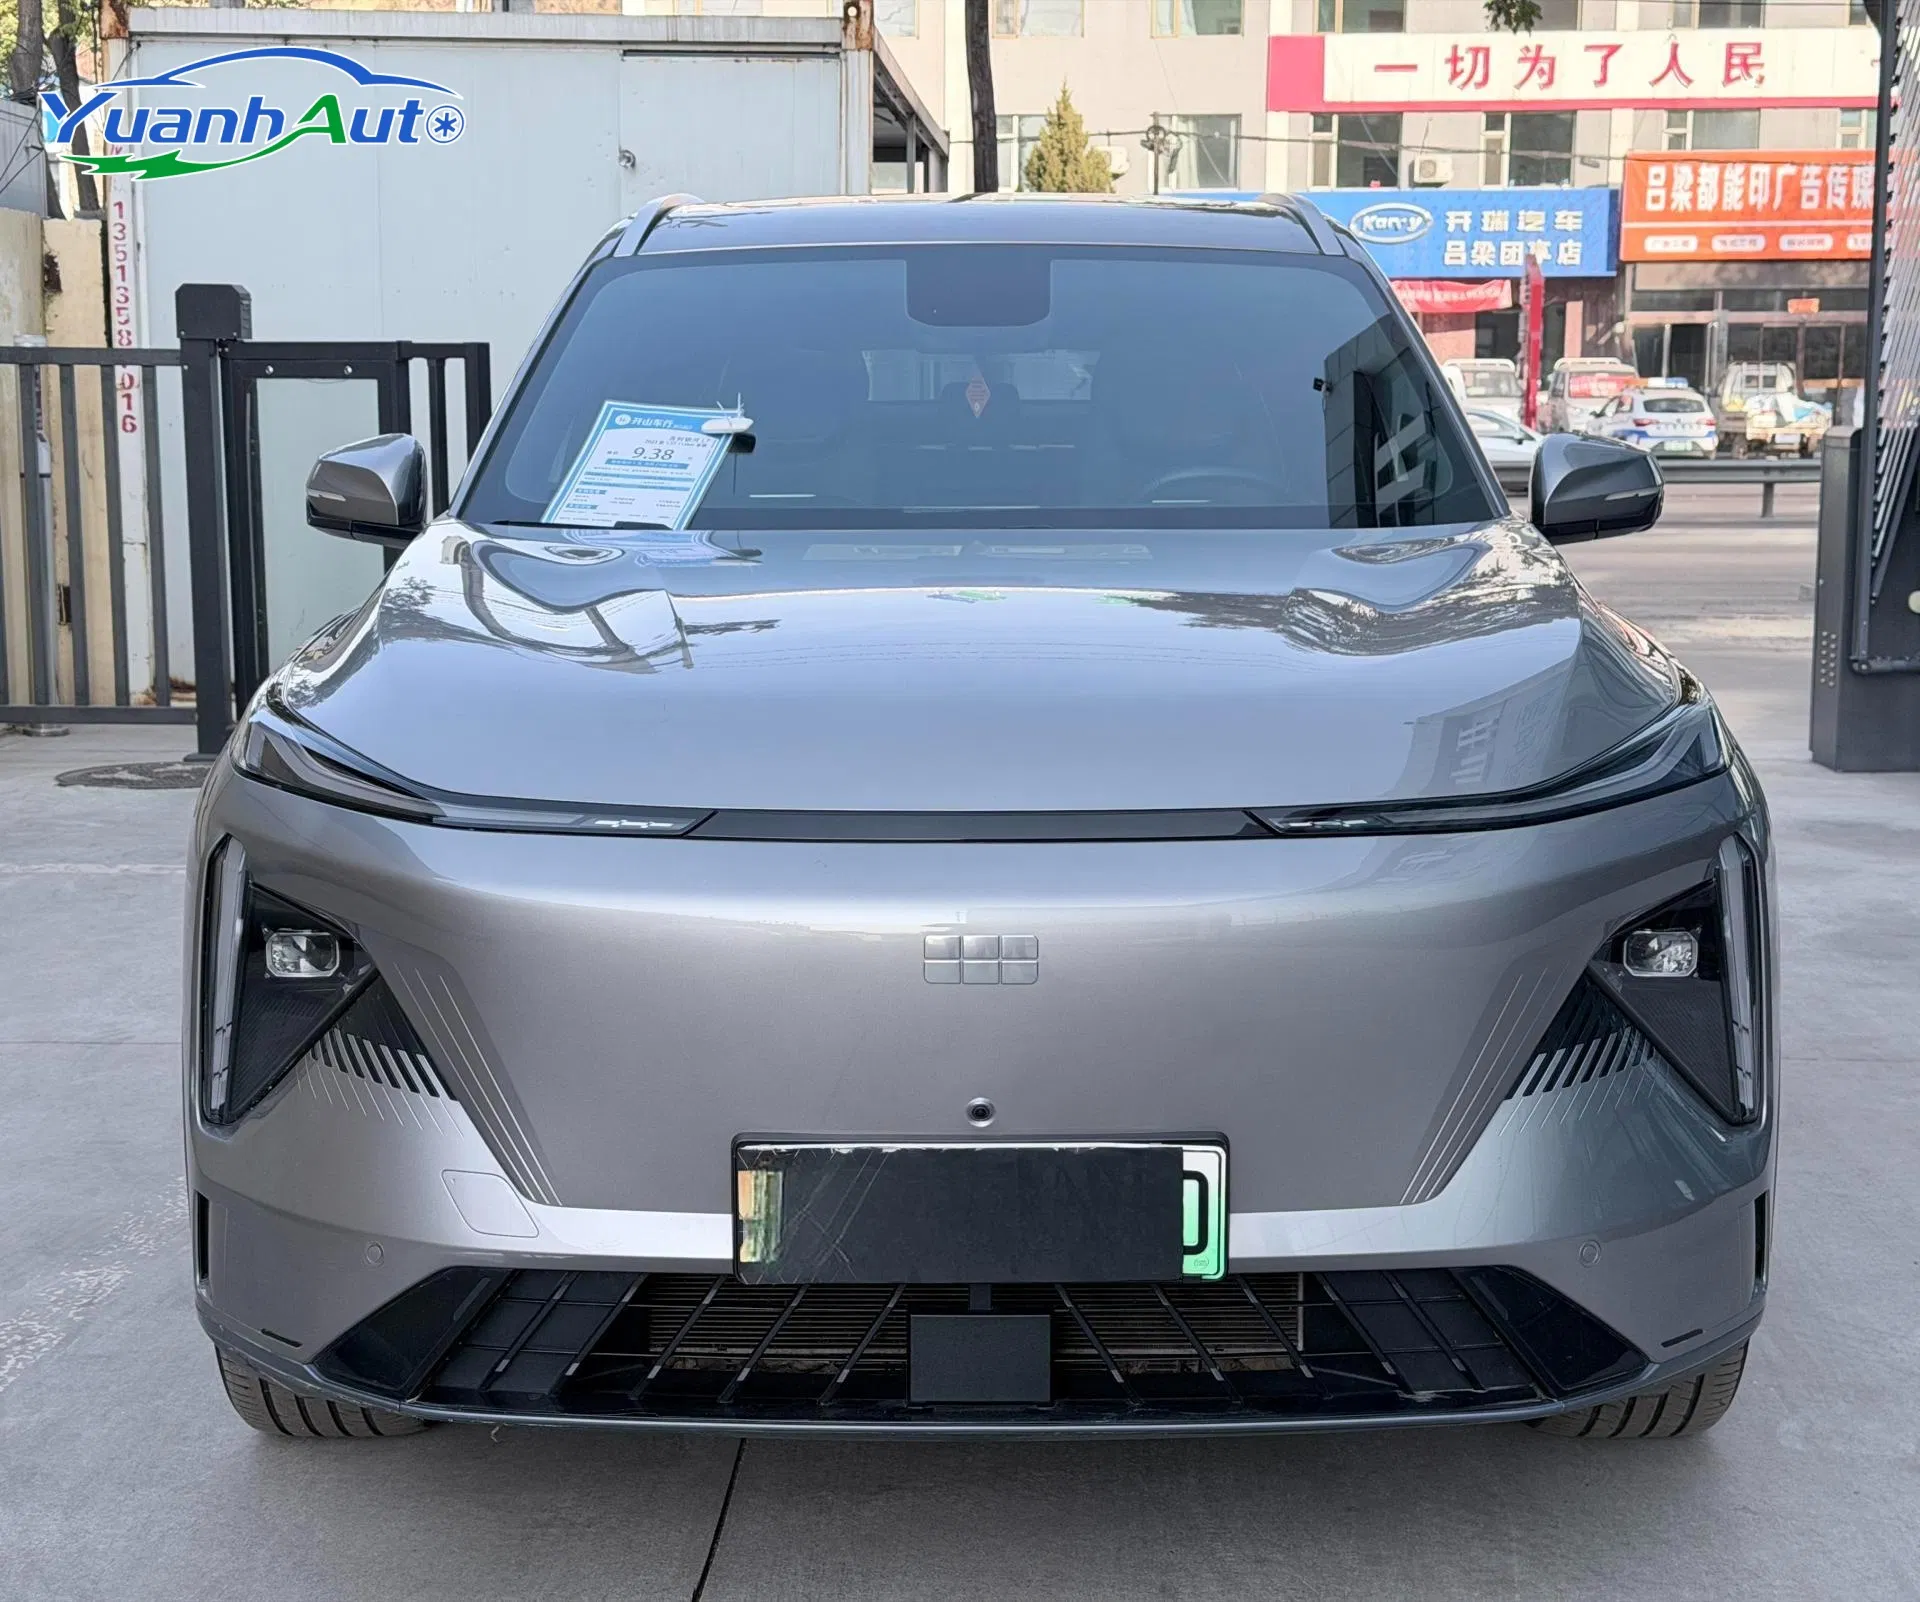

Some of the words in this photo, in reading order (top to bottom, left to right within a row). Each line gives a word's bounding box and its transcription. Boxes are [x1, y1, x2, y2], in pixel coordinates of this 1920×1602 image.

[1373, 41, 1766, 91] 一切为了人民
[1445, 210, 1584, 233] 开瑞汽车
[113, 201, 138, 434] 1351358016
[631, 446, 675, 461] 9.38
